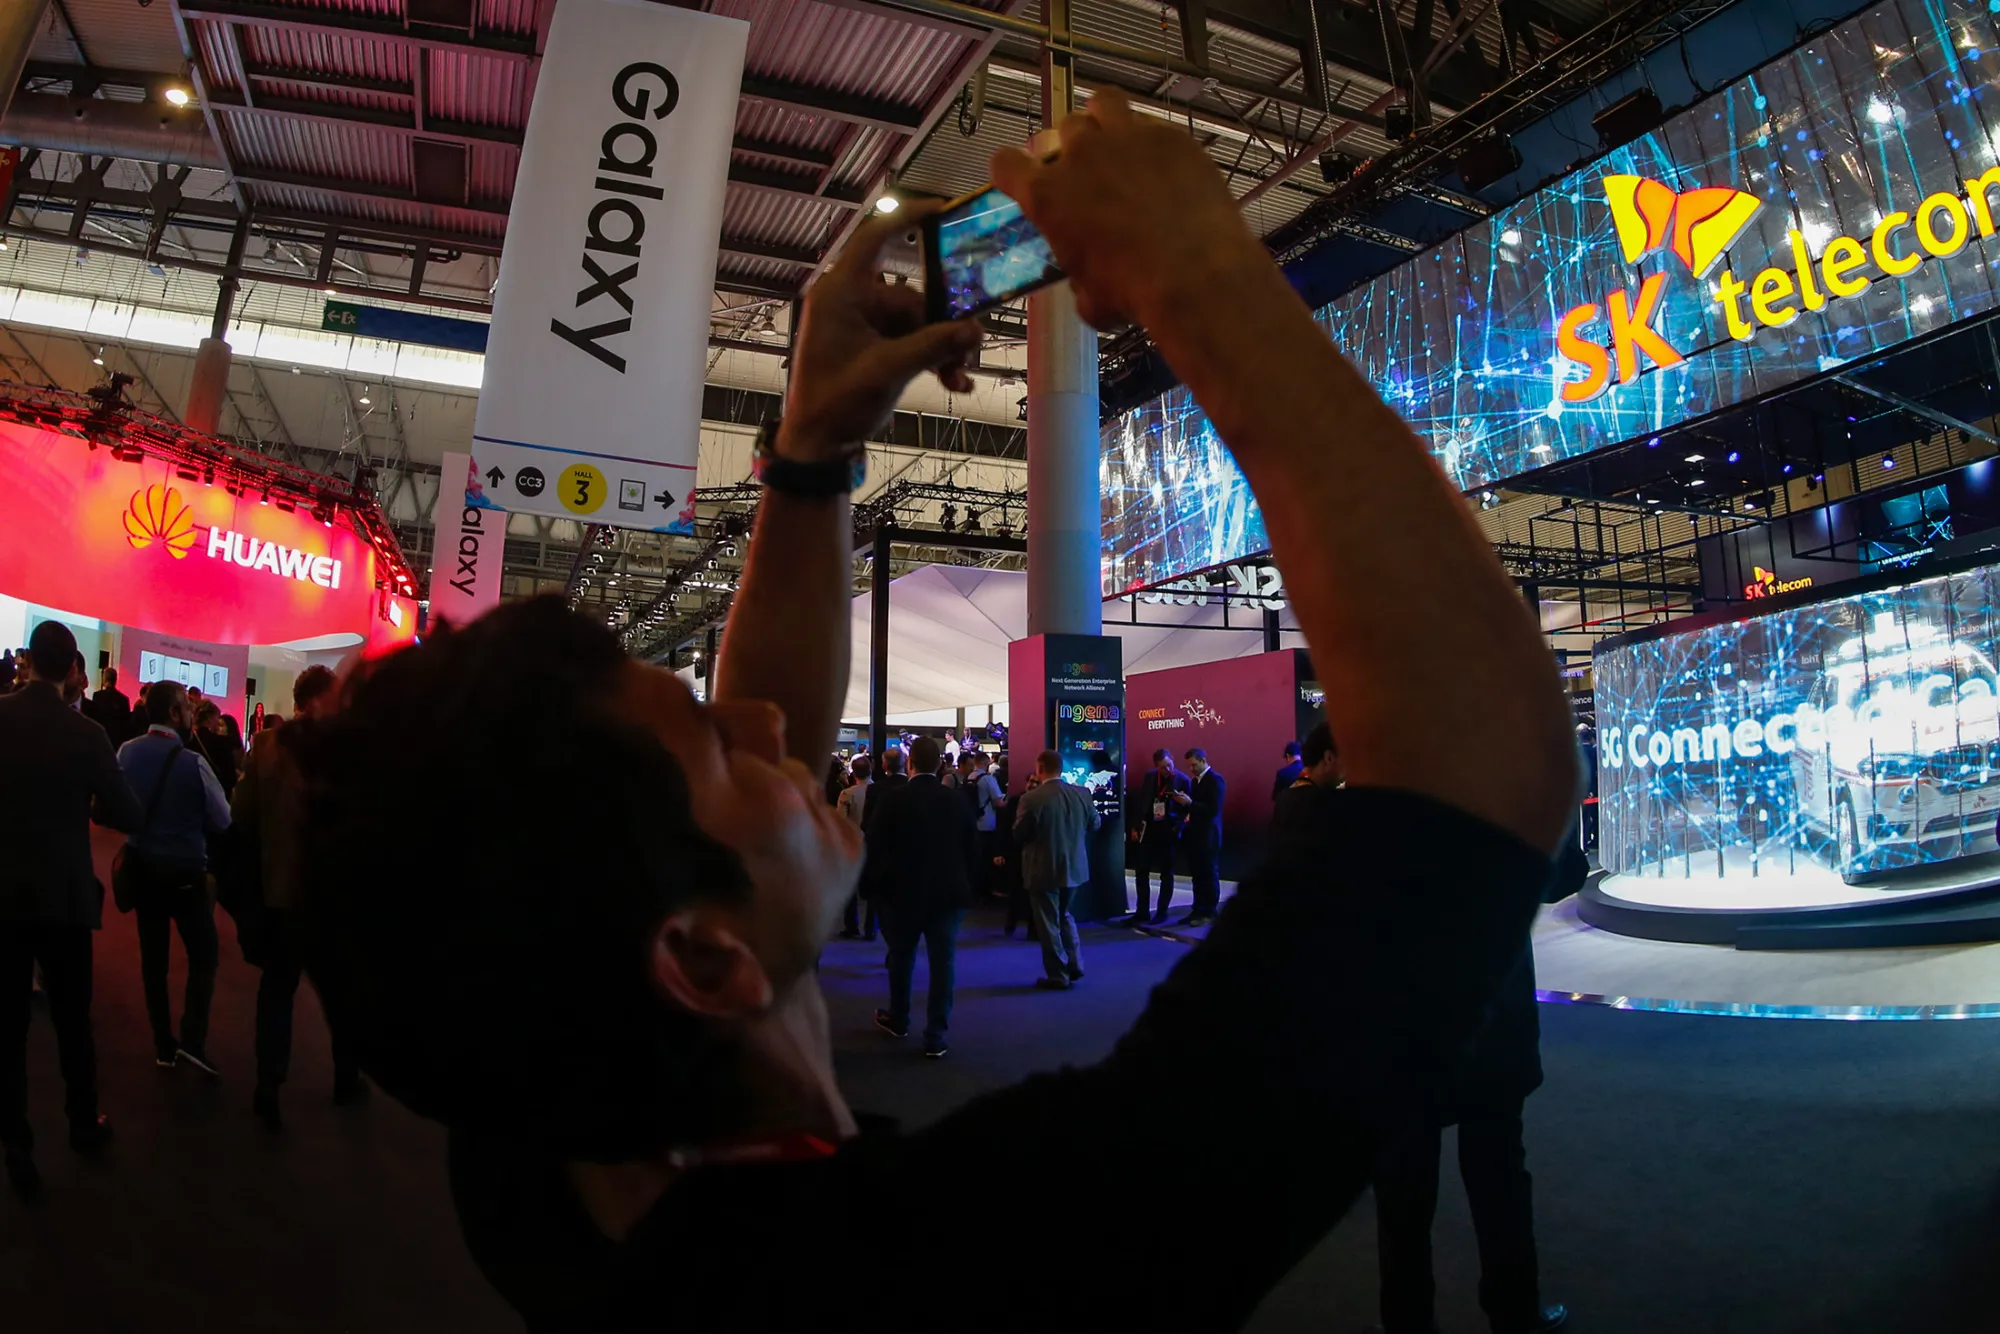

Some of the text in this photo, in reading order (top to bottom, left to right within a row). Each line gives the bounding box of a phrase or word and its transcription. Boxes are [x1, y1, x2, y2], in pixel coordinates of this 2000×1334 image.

[550, 62, 679, 374] Galaxy
[1557, 271, 1687, 402] SK
[518, 475, 543, 488] CC3
[574, 471, 593, 480] HALL
[573, 480, 590, 506] 3
[207, 526, 341, 590] HUAWEI
[450, 507, 485, 597] alaxy
[1745, 582, 1766, 600] SK
[1570, 696, 1593, 706] rience
[1060, 704, 1120, 723] ngena
[1139, 708, 1165, 719] CONNECT
[1148, 718, 1185, 730] EVERYTHING
[1075, 741, 1104, 750] ngena
[1601, 726, 1624, 768] 5G
